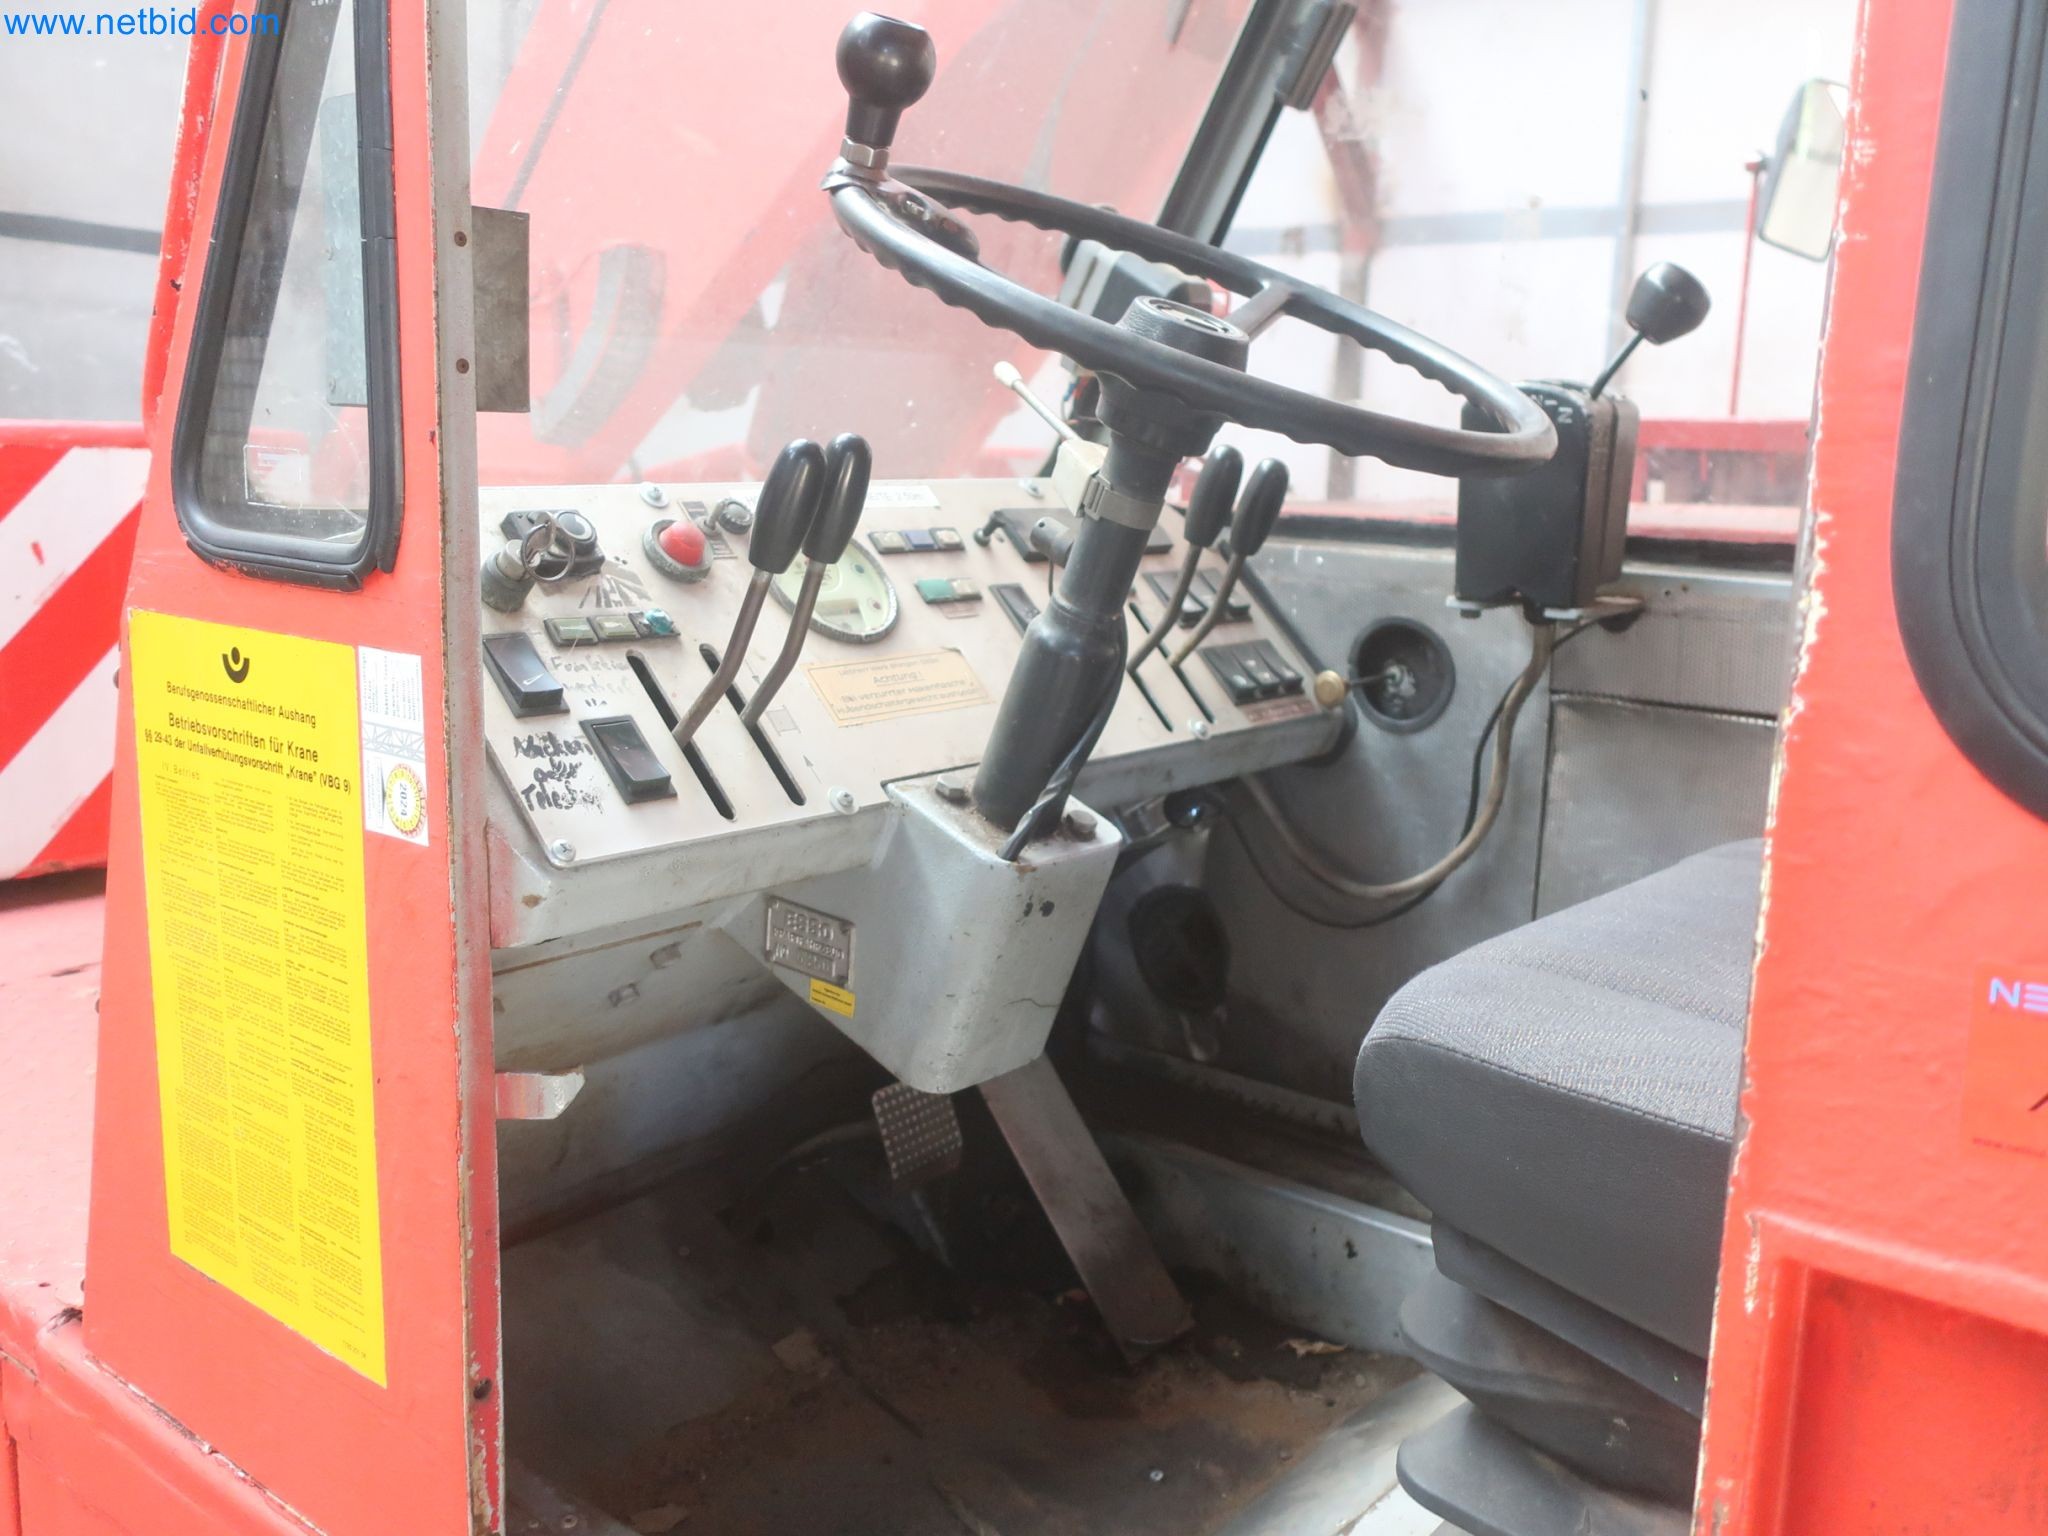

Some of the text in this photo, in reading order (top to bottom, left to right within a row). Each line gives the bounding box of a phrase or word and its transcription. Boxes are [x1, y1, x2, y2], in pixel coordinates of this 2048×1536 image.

[166, 681, 317, 729] Berufsgenossenschaftlicher Aushang
[168, 711, 319, 763] Betriebsvorschriften für Krane
[174, 734, 186, 748] der
[187, 739, 284, 775] Unfallverhütungsvorschrift
[319, 772, 341, 791] (VBG
[343, 778, 352, 796] 9)
[399, 782, 408, 816] 2024
